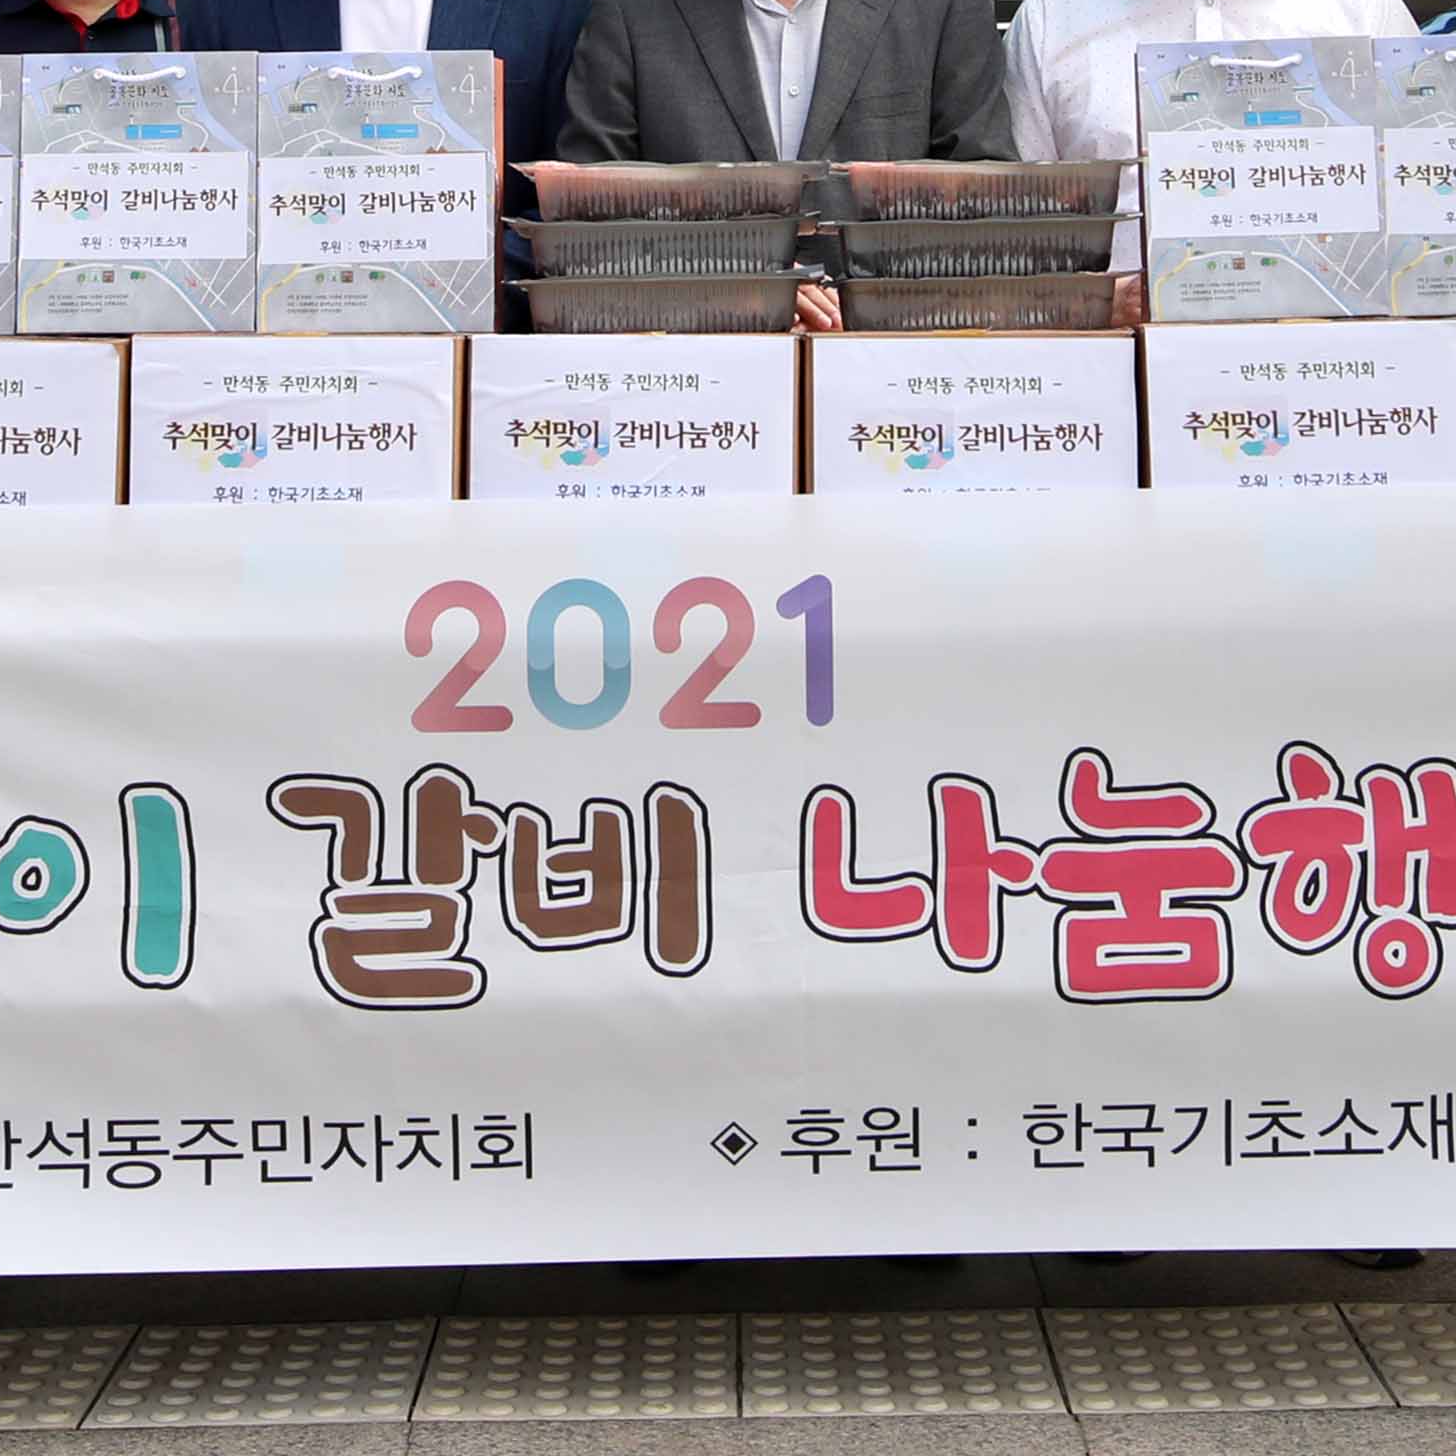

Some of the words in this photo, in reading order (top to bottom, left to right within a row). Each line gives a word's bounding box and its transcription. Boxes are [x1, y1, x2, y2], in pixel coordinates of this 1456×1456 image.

[1159, 167, 1236, 191] 추석맞이
[1249, 163, 1367, 188] 갈비나눔행사
[31, 189, 108, 212] 추석맞이
[121, 188, 238, 212] 갈비나눔행사
[270, 192, 346, 217] 추석맞이
[359, 189, 476, 215] 갈비나눔행사
[1210, 214, 1233, 228] 후원
[1249, 212, 1318, 227] 한국기초소재
[81, 236, 102, 250] 후원
[119, 236, 187, 250] 한국기초소재
[320, 240, 342, 255] 후원
[358, 239, 427, 254] 한국기초소재
[565, 372, 610, 392] 만석동
[622, 373, 699, 392] 주민자치회
[1240, 362, 1287, 382] 만석동
[1297, 360, 1375, 380] 주민자치회
[223, 375, 269, 394] 만석동
[279, 375, 358, 393] 주민자치회
[907, 376, 954, 395] 만석동
[966, 376, 1042, 395] 주민자치회
[163, 421, 257, 452] 추석맞이
[271, 422, 417, 452] 갈비나눔행사
[505, 419, 599, 449] 추석맞이
[614, 420, 760, 450] 갈비나눔행사
[1183, 410, 1279, 441] 추석맞이
[1293, 406, 1438, 437] 갈비나눔행사
[848, 423, 944, 453] 추석맞이
[958, 423, 1103, 452] 갈비나눔행사
[213, 486, 244, 503] 후원
[268, 486, 363, 503] 한국기초소재
[404, 573, 835, 734] 2021
[265, 762, 714, 1012] 갈비
[780, 1106, 922, 1175] 후원
[1022, 1092, 1455, 1169] 한국기초소재
